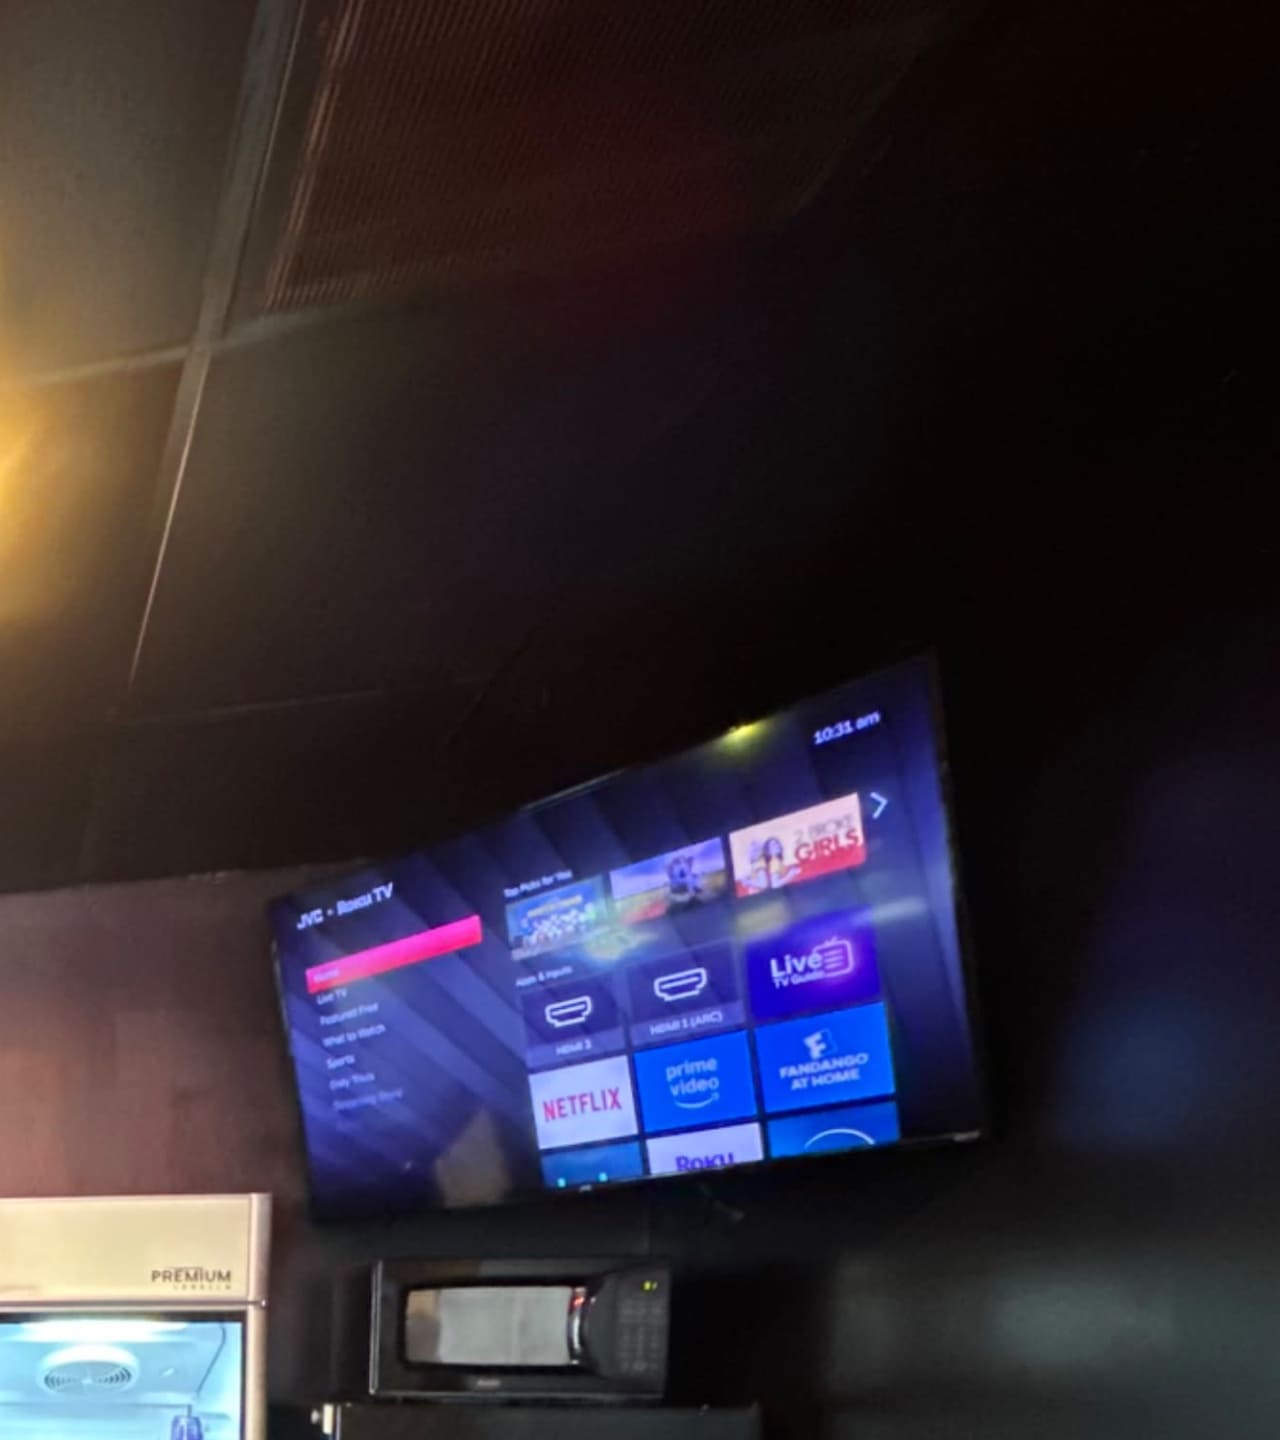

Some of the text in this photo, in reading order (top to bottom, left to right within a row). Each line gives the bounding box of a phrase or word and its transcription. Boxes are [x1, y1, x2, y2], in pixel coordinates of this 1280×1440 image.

[813, 710, 881, 745] 10:31 am
[795, 826, 860, 864] GIRLS
[296, 909, 324, 930] JVC
[373, 882, 394, 902] TV
[770, 951, 824, 980] Live
[665, 1058, 718, 1082] prime
[778, 1052, 870, 1079] FANDANGO
[790, 1066, 861, 1091] AT HOME
[669, 1076, 720, 1097] video
[543, 1087, 622, 1124] NETFLIX
[151, 1267, 232, 1283] PREMIUM
